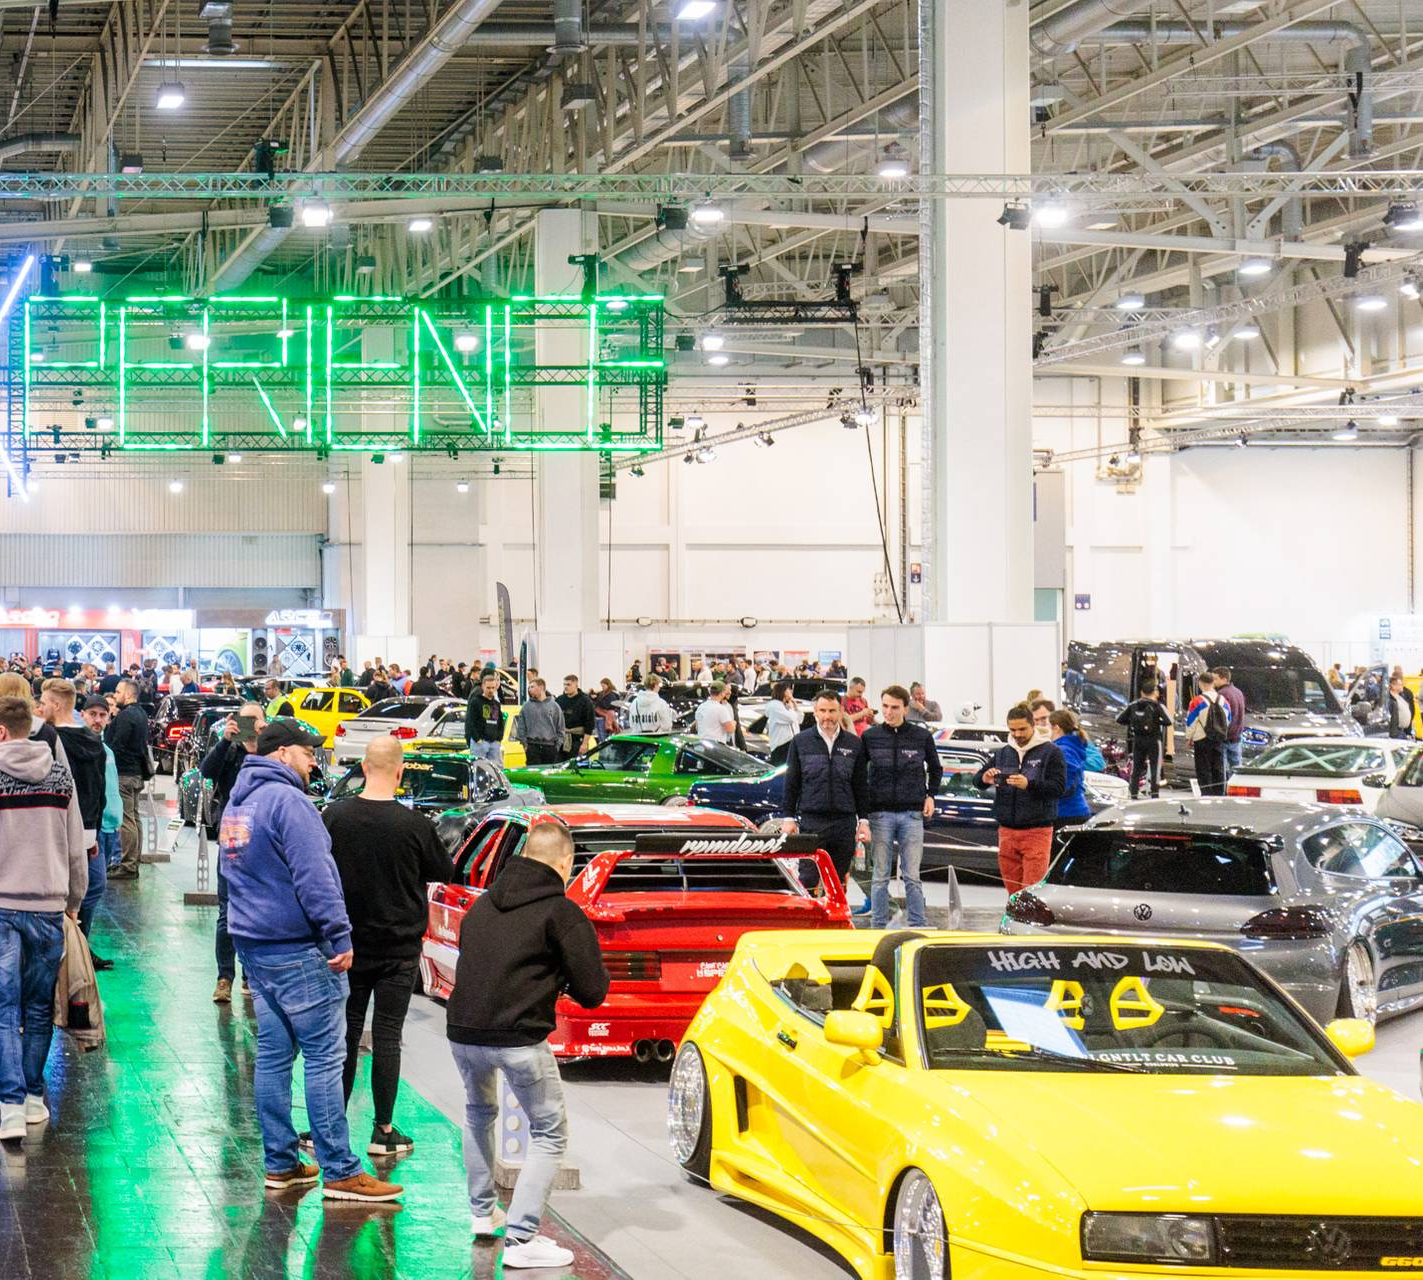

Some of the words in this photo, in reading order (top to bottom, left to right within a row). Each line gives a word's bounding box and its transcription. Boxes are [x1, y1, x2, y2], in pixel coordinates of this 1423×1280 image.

[679, 832, 788, 856] rpmdepot
[987, 951, 1060, 972] HIGH
[1071, 951, 1129, 970] AND
[1142, 951, 1196, 976] LOW
[1155, 1053, 1188, 1063] CAR
[1191, 1055, 1236, 1066] CLUB
